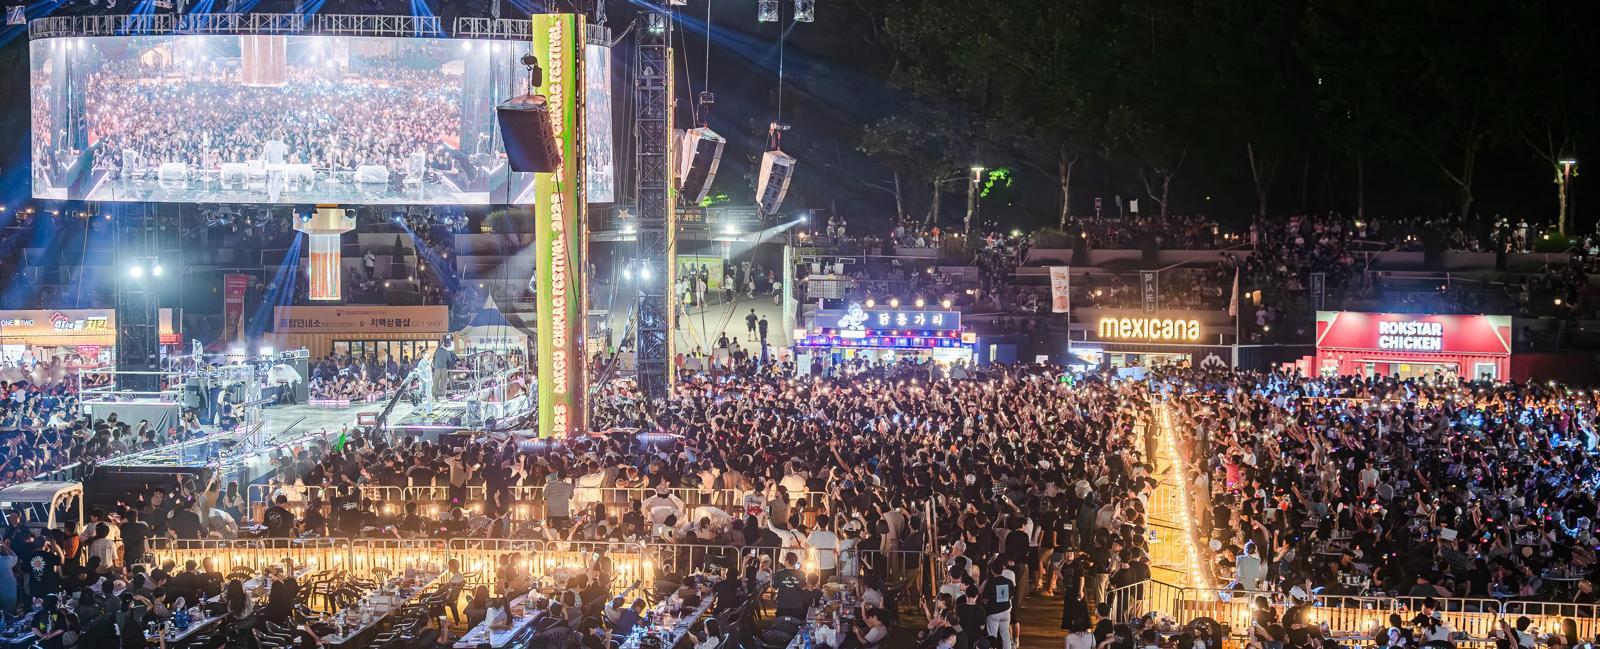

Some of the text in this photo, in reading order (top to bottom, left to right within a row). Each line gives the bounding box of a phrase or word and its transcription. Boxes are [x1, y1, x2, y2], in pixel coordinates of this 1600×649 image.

[549, 19, 562, 82] FESTIVAL
[550, 192, 564, 231] 2025
[551, 232, 566, 296] FESTIVAL
[552, 296, 566, 348] CHIMAC
[1099, 317, 1200, 340] mexicana
[1379, 336, 1442, 350] CHICKEN
[553, 350, 567, 394] DAEGU
